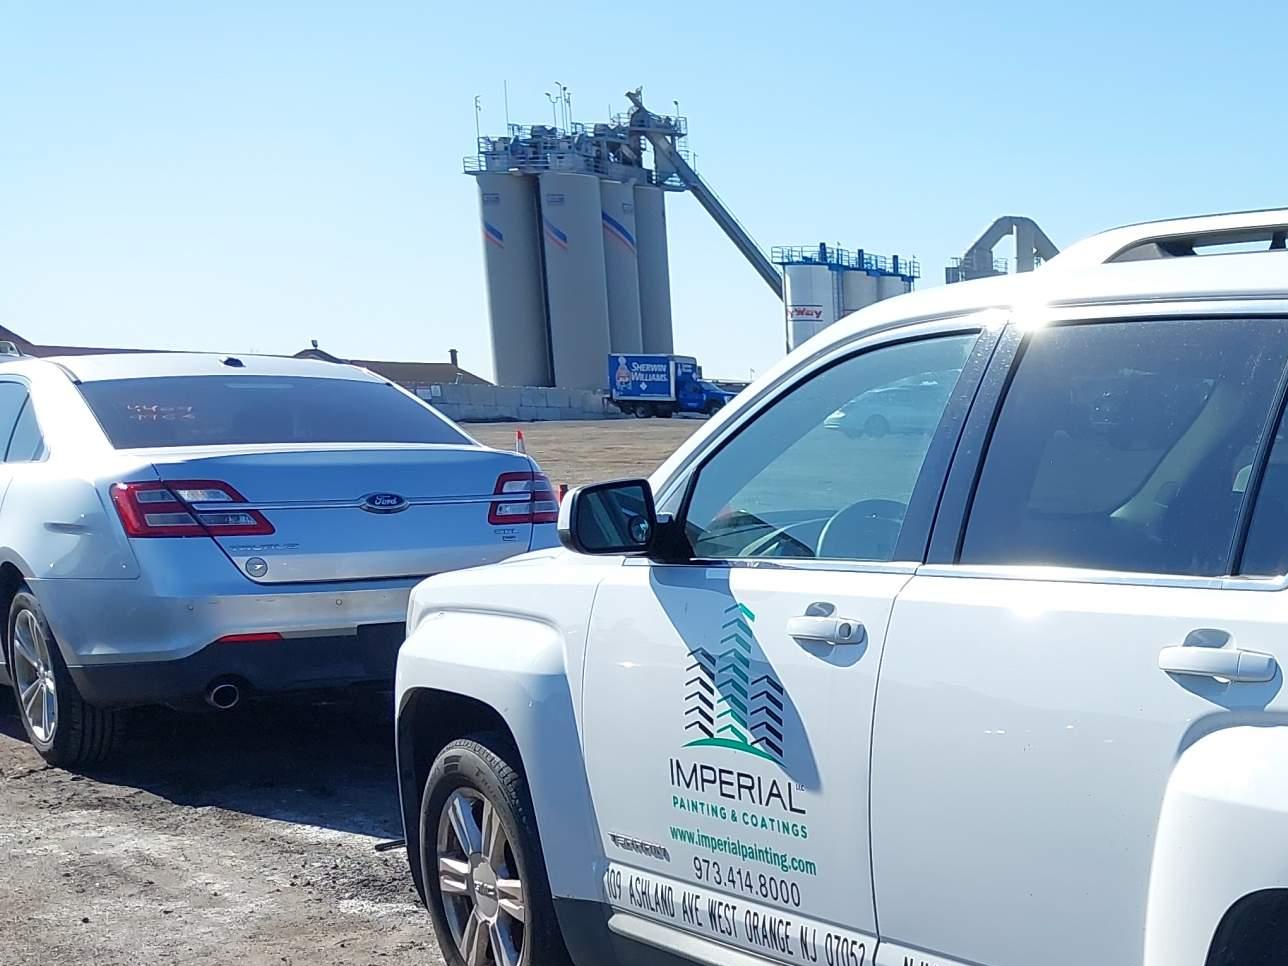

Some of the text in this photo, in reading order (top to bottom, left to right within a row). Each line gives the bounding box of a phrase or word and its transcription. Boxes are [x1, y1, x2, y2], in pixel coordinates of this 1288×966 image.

[631, 362, 667, 372] SHERWIN
[374, 495, 397, 506] Ford
[669, 757, 806, 815] IMPERIAL
[672, 795, 808, 839] PAINTING & COATINGS
[670, 825, 817, 876] www.imperialpainting.com
[693, 856, 801, 907] 973.414.8000
[606, 867, 622, 900] 109
[628, 875, 675, 918] ASHLAND
[681, 891, 703, 927] AVE
[708, 898, 738, 939] WEST
[744, 909, 794, 956] ORANGE
[799, 924, 817, 962] NJ
